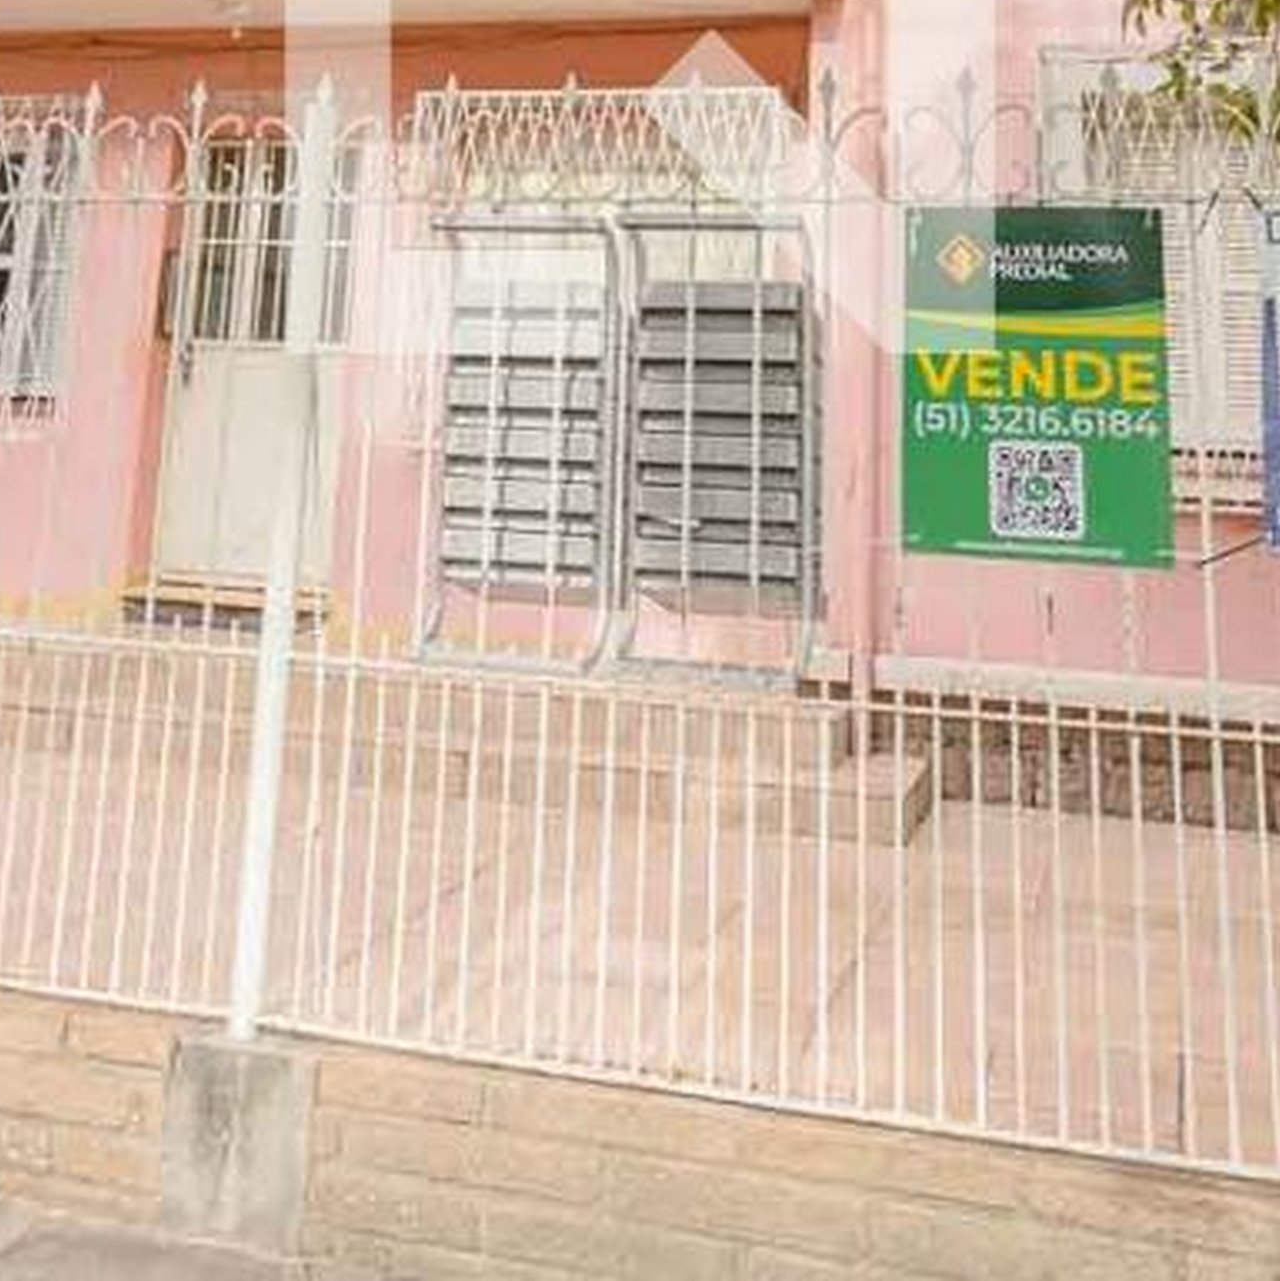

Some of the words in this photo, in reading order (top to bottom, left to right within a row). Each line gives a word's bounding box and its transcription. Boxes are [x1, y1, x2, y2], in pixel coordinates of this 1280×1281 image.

[989, 244, 1130, 265] AUXILIADORA
[989, 262, 1073, 281] PREDIAL
[915, 348, 1161, 404] VENDE
[915, 400, 969, 440] (51)
[983, 404, 1161, 439] 3216.6184
